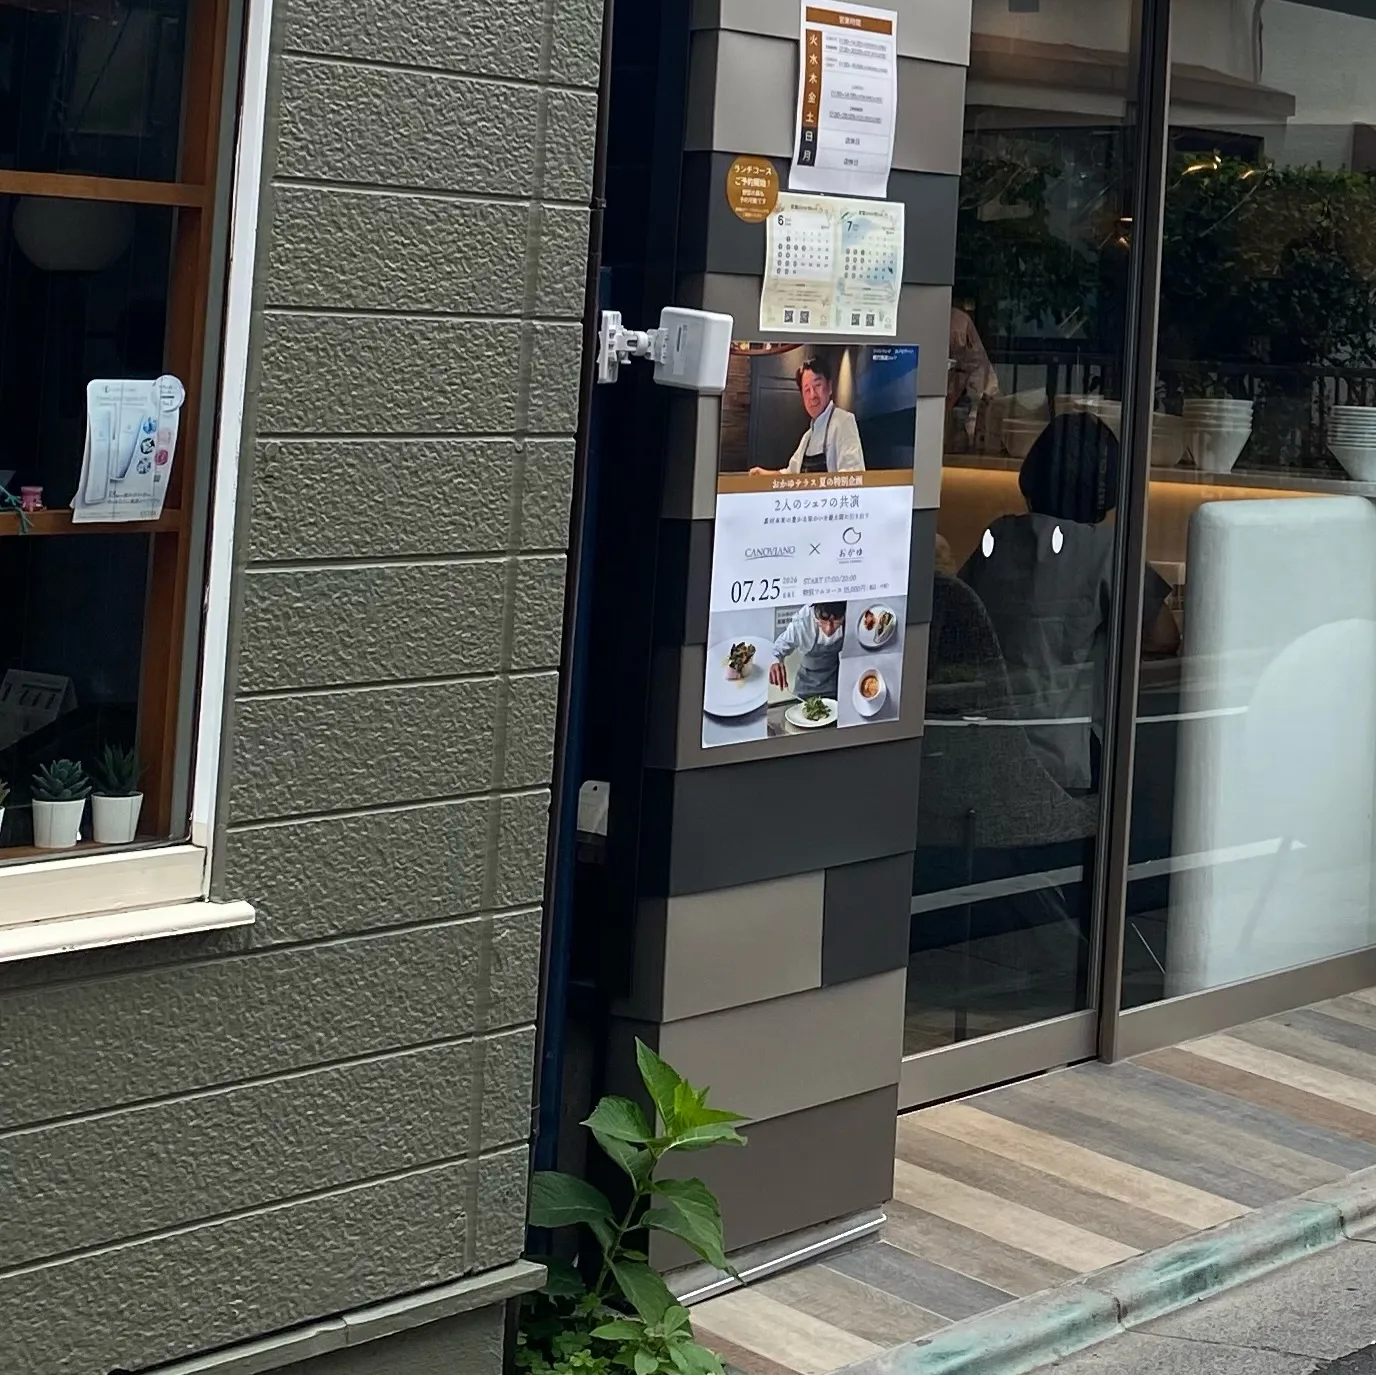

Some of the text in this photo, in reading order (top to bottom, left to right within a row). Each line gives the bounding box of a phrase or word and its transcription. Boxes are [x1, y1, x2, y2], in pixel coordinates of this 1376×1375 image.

[734, 165, 772, 175] ランチコース
[777, 215, 784, 226] 6
[847, 220, 853, 232] 7
[772, 478, 817, 489] おかゆテラス
[774, 494, 860, 511] 2人のシェフの共演
[745, 545, 796, 559] CANOVIANO
[839, 548, 863, 558] おかゆ
[803, 576, 824, 585] START
[731, 578, 781, 603] 07.25
